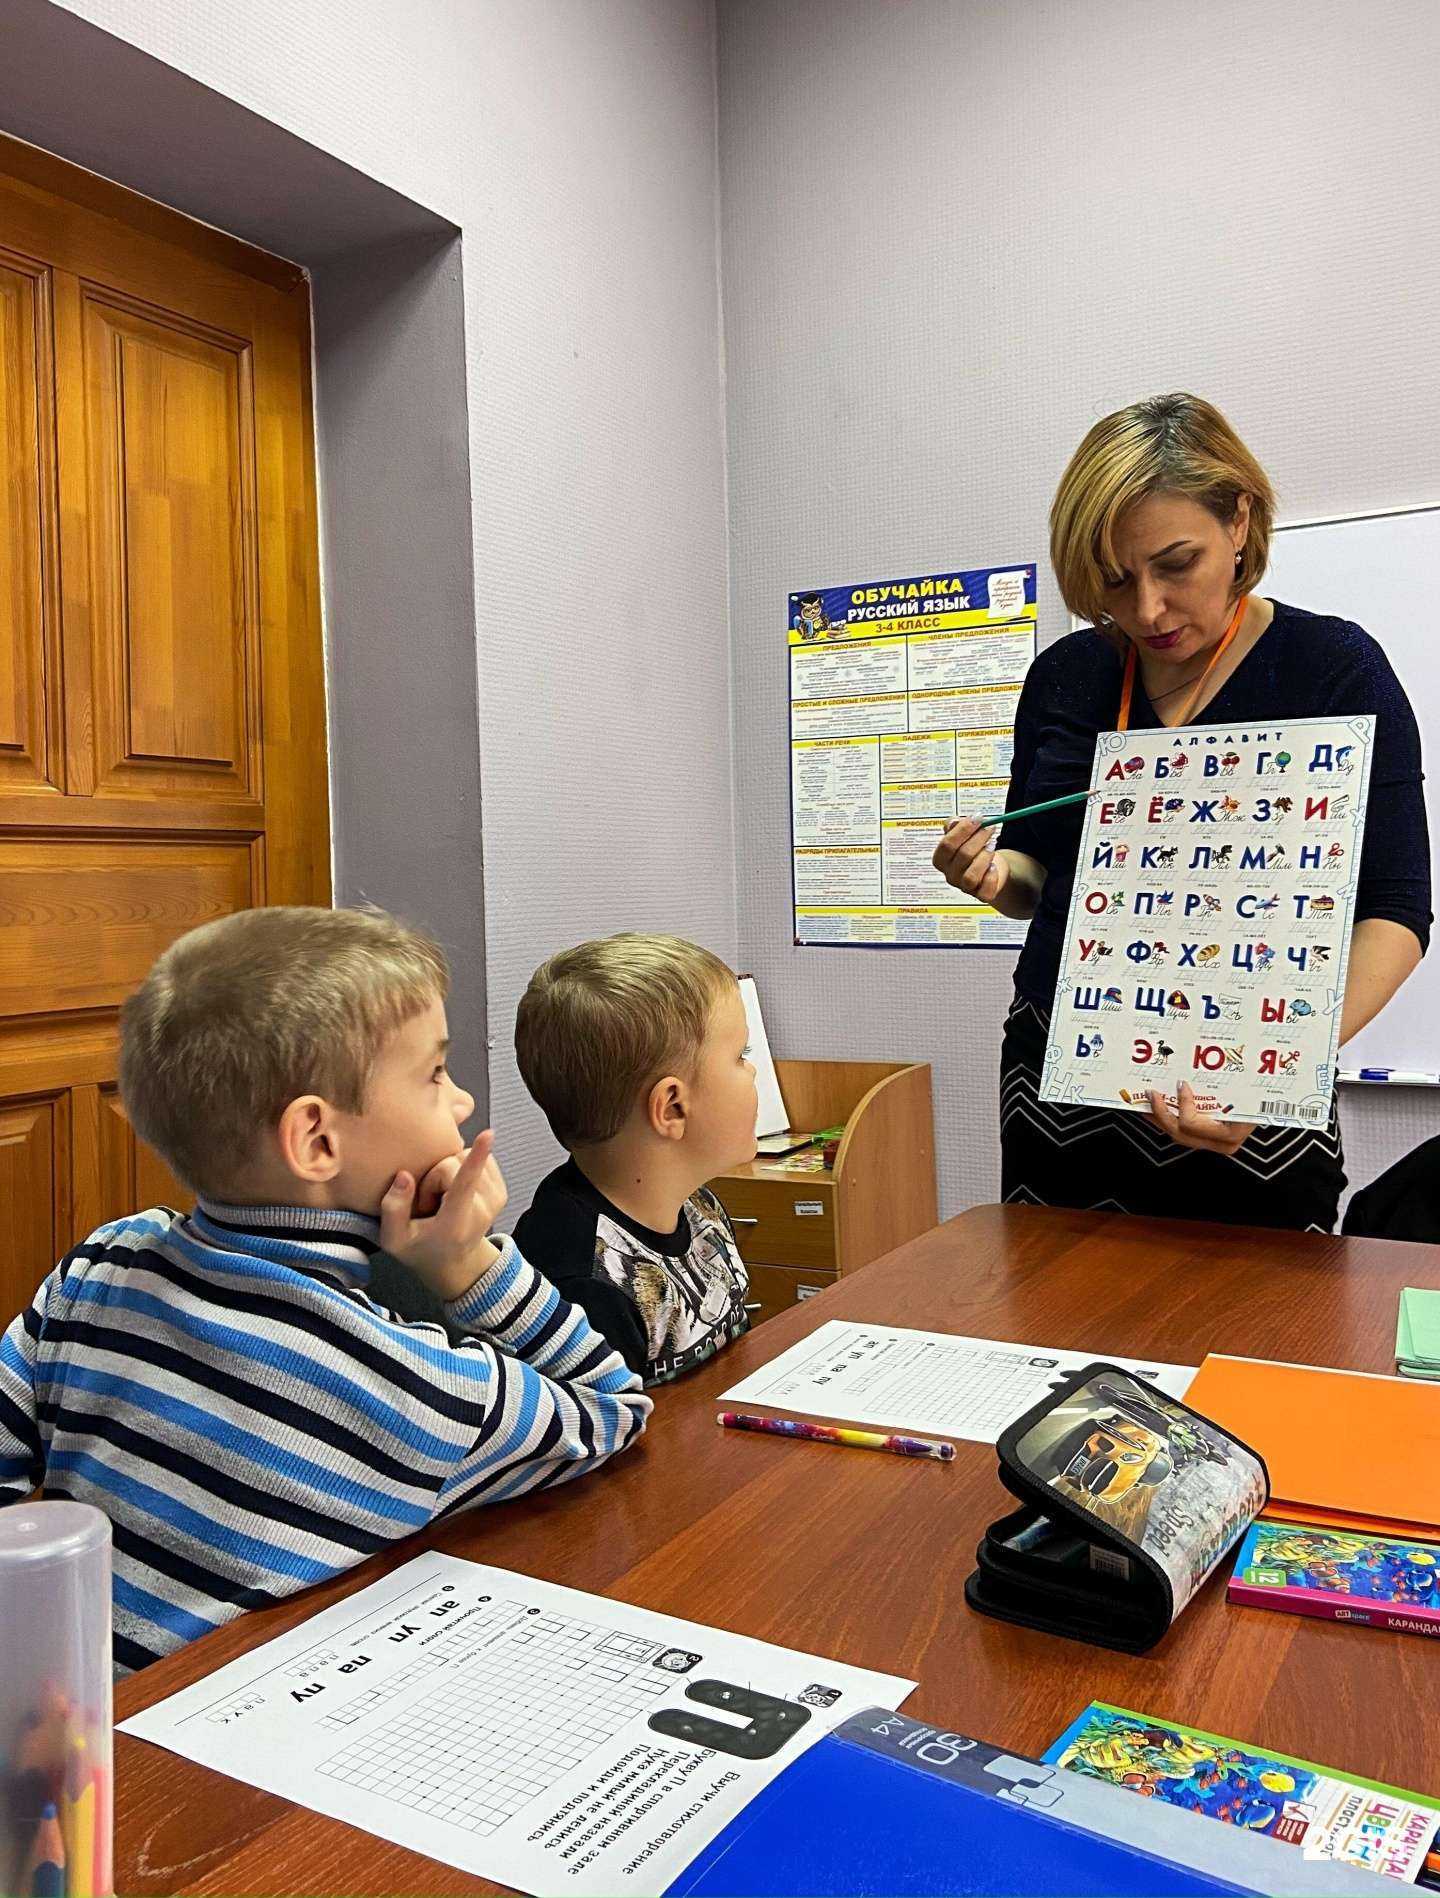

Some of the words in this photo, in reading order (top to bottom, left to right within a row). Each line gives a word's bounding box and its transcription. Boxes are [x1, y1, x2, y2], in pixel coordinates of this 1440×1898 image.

[851, 578, 964, 605] ОБУЧАЙКА
[847, 599, 919, 621] РУССКИЙ
[923, 595, 970, 614] ЯЗЫК
[876, 623, 893, 633] 3-4
[897, 617, 940, 631] КЛАСС
[1173, 732, 1282, 747] АЛФАВИТ
[1105, 759, 1125, 780] А
[1154, 757, 1169, 778] Б
[1203, 755, 1219, 777] В
[1256, 752, 1272, 774] Г
[1308, 744, 1333, 772] Д
[1100, 803, 1115, 824] Е
[1148, 796, 1164, 823] Ё
[1189, 800, 1219, 822] Ж
[1252, 799, 1271, 822] З
[1304, 796, 1328, 820] И
[1092, 841, 1113, 869] Й
[1141, 846, 1160, 869] К
[1188, 847, 1211, 869] Л
[1239, 845, 1266, 869] М
[1300, 845, 1321, 869] Н
[1085, 892, 1108, 914] О
[1134, 892, 1154, 914] П
[1184, 894, 1201, 916] Р
[1236, 895, 1257, 918] С
[1293, 895, 1310, 918] Т
[1079, 939, 1096, 961] У
[1126, 940, 1151, 963] Ф
[1177, 944, 1198, 967] Х
[1232, 944, 1253, 972] Ц
[1288, 947, 1307, 971] Ч
[1074, 987, 1101, 1010] Ш
[1135, 987, 1165, 1017] Щ
[1202, 995, 1220, 1019] Ъ
[1261, 998, 1286, 1023] Ы
[1076, 1034, 1091, 1057] Ь
[1131, 1039, 1152, 1064] Э
[1193, 1045, 1225, 1070] Ю
[1257, 1049, 1277, 1074] Я
[430, 1600, 460, 1617] ап
[388, 1623, 422, 1643] уп
[338, 1654, 373, 1675] па
[290, 1682, 326, 1703] пу
[597, 1743, 651, 1784] Подойди
[637, 1748, 670, 1771] Нука
[679, 1749, 717, 1776] Букву
[916, 1733, 978, 1766] 30
[602, 1771, 641, 1801] милый
[609, 1751, 690, 1817] Перекладиной
[669, 1776, 686, 1785] П
[700, 1771, 741, 1802] Выучи
[527, 1792, 590, 1842] подтянись
[586, 1801, 605, 1814] не
[598, 1793, 663, 1848] спортивном
[545, 1814, 587, 1849] ленись
[560, 1817, 612, 1859] назвали
[622, 1802, 704, 1875] стихотворение
[567, 1849, 600, 1875] зале
